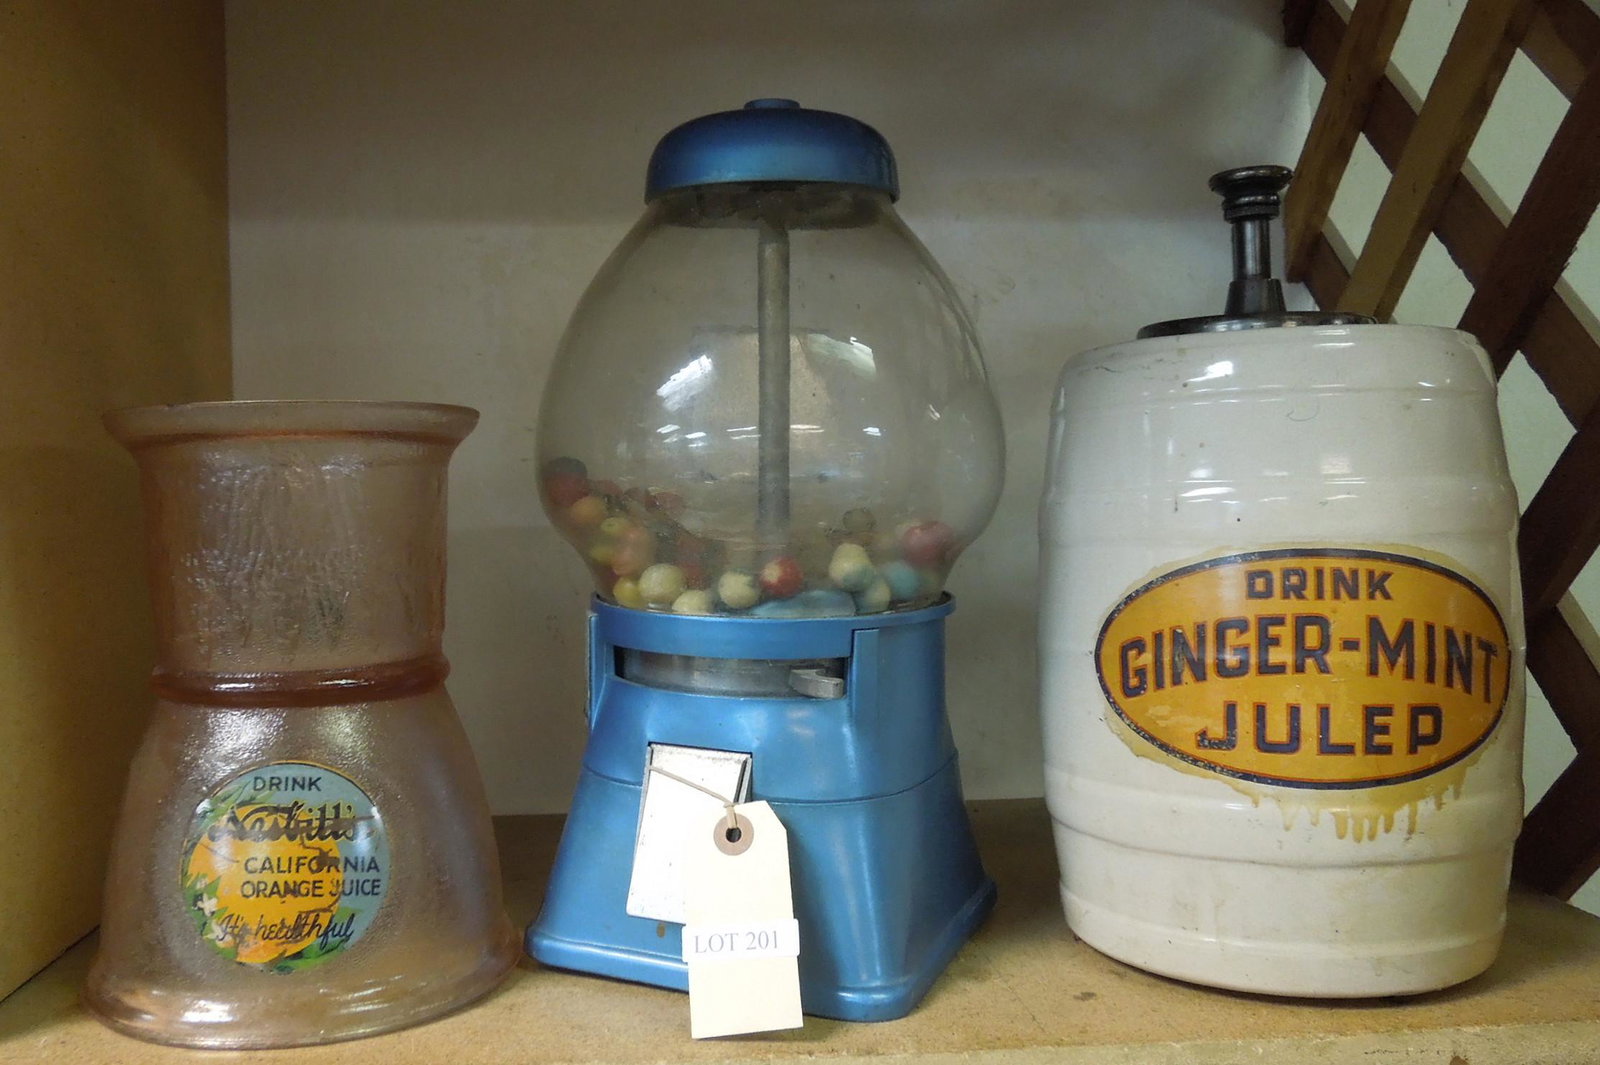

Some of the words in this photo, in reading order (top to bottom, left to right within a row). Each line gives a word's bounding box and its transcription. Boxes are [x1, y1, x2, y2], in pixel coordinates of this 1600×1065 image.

[1245, 566, 1395, 602] DRINK
[1119, 613, 1499, 704] GINGER-MINT
[1195, 700, 1444, 757] JULEP
[252, 776, 322, 792] DRINK
[240, 880, 324, 899] ORANGE
[329, 878, 382, 898] JUICE
[255, 913, 356, 951] healthful
[694, 932, 740, 954] LOT
[745, 930, 778, 951] 201
